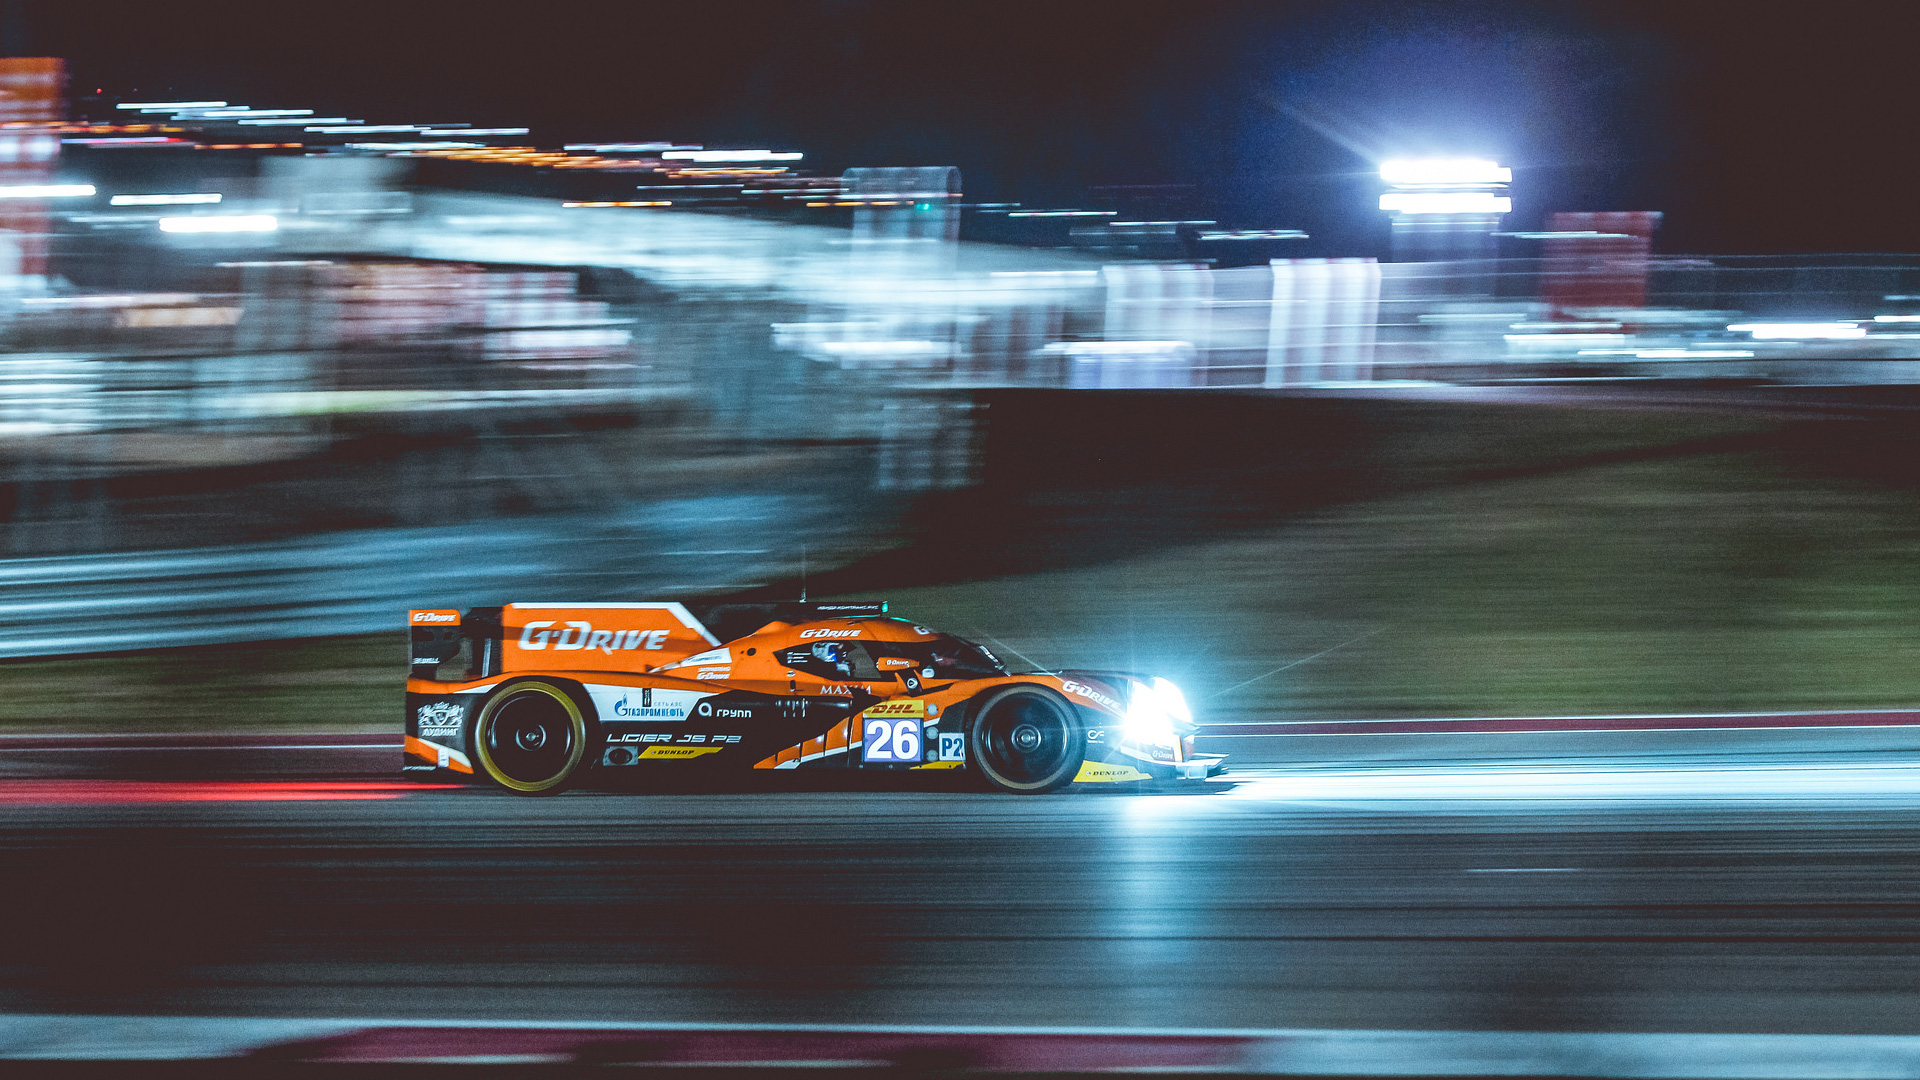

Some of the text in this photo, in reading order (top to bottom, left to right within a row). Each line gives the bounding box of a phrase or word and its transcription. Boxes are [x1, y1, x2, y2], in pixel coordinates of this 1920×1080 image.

[871, 704, 915, 714] DHL
[606, 733, 742, 743] LIGIER JS P2
[866, 720, 919, 760] 26
[941, 738, 963, 757] P2
